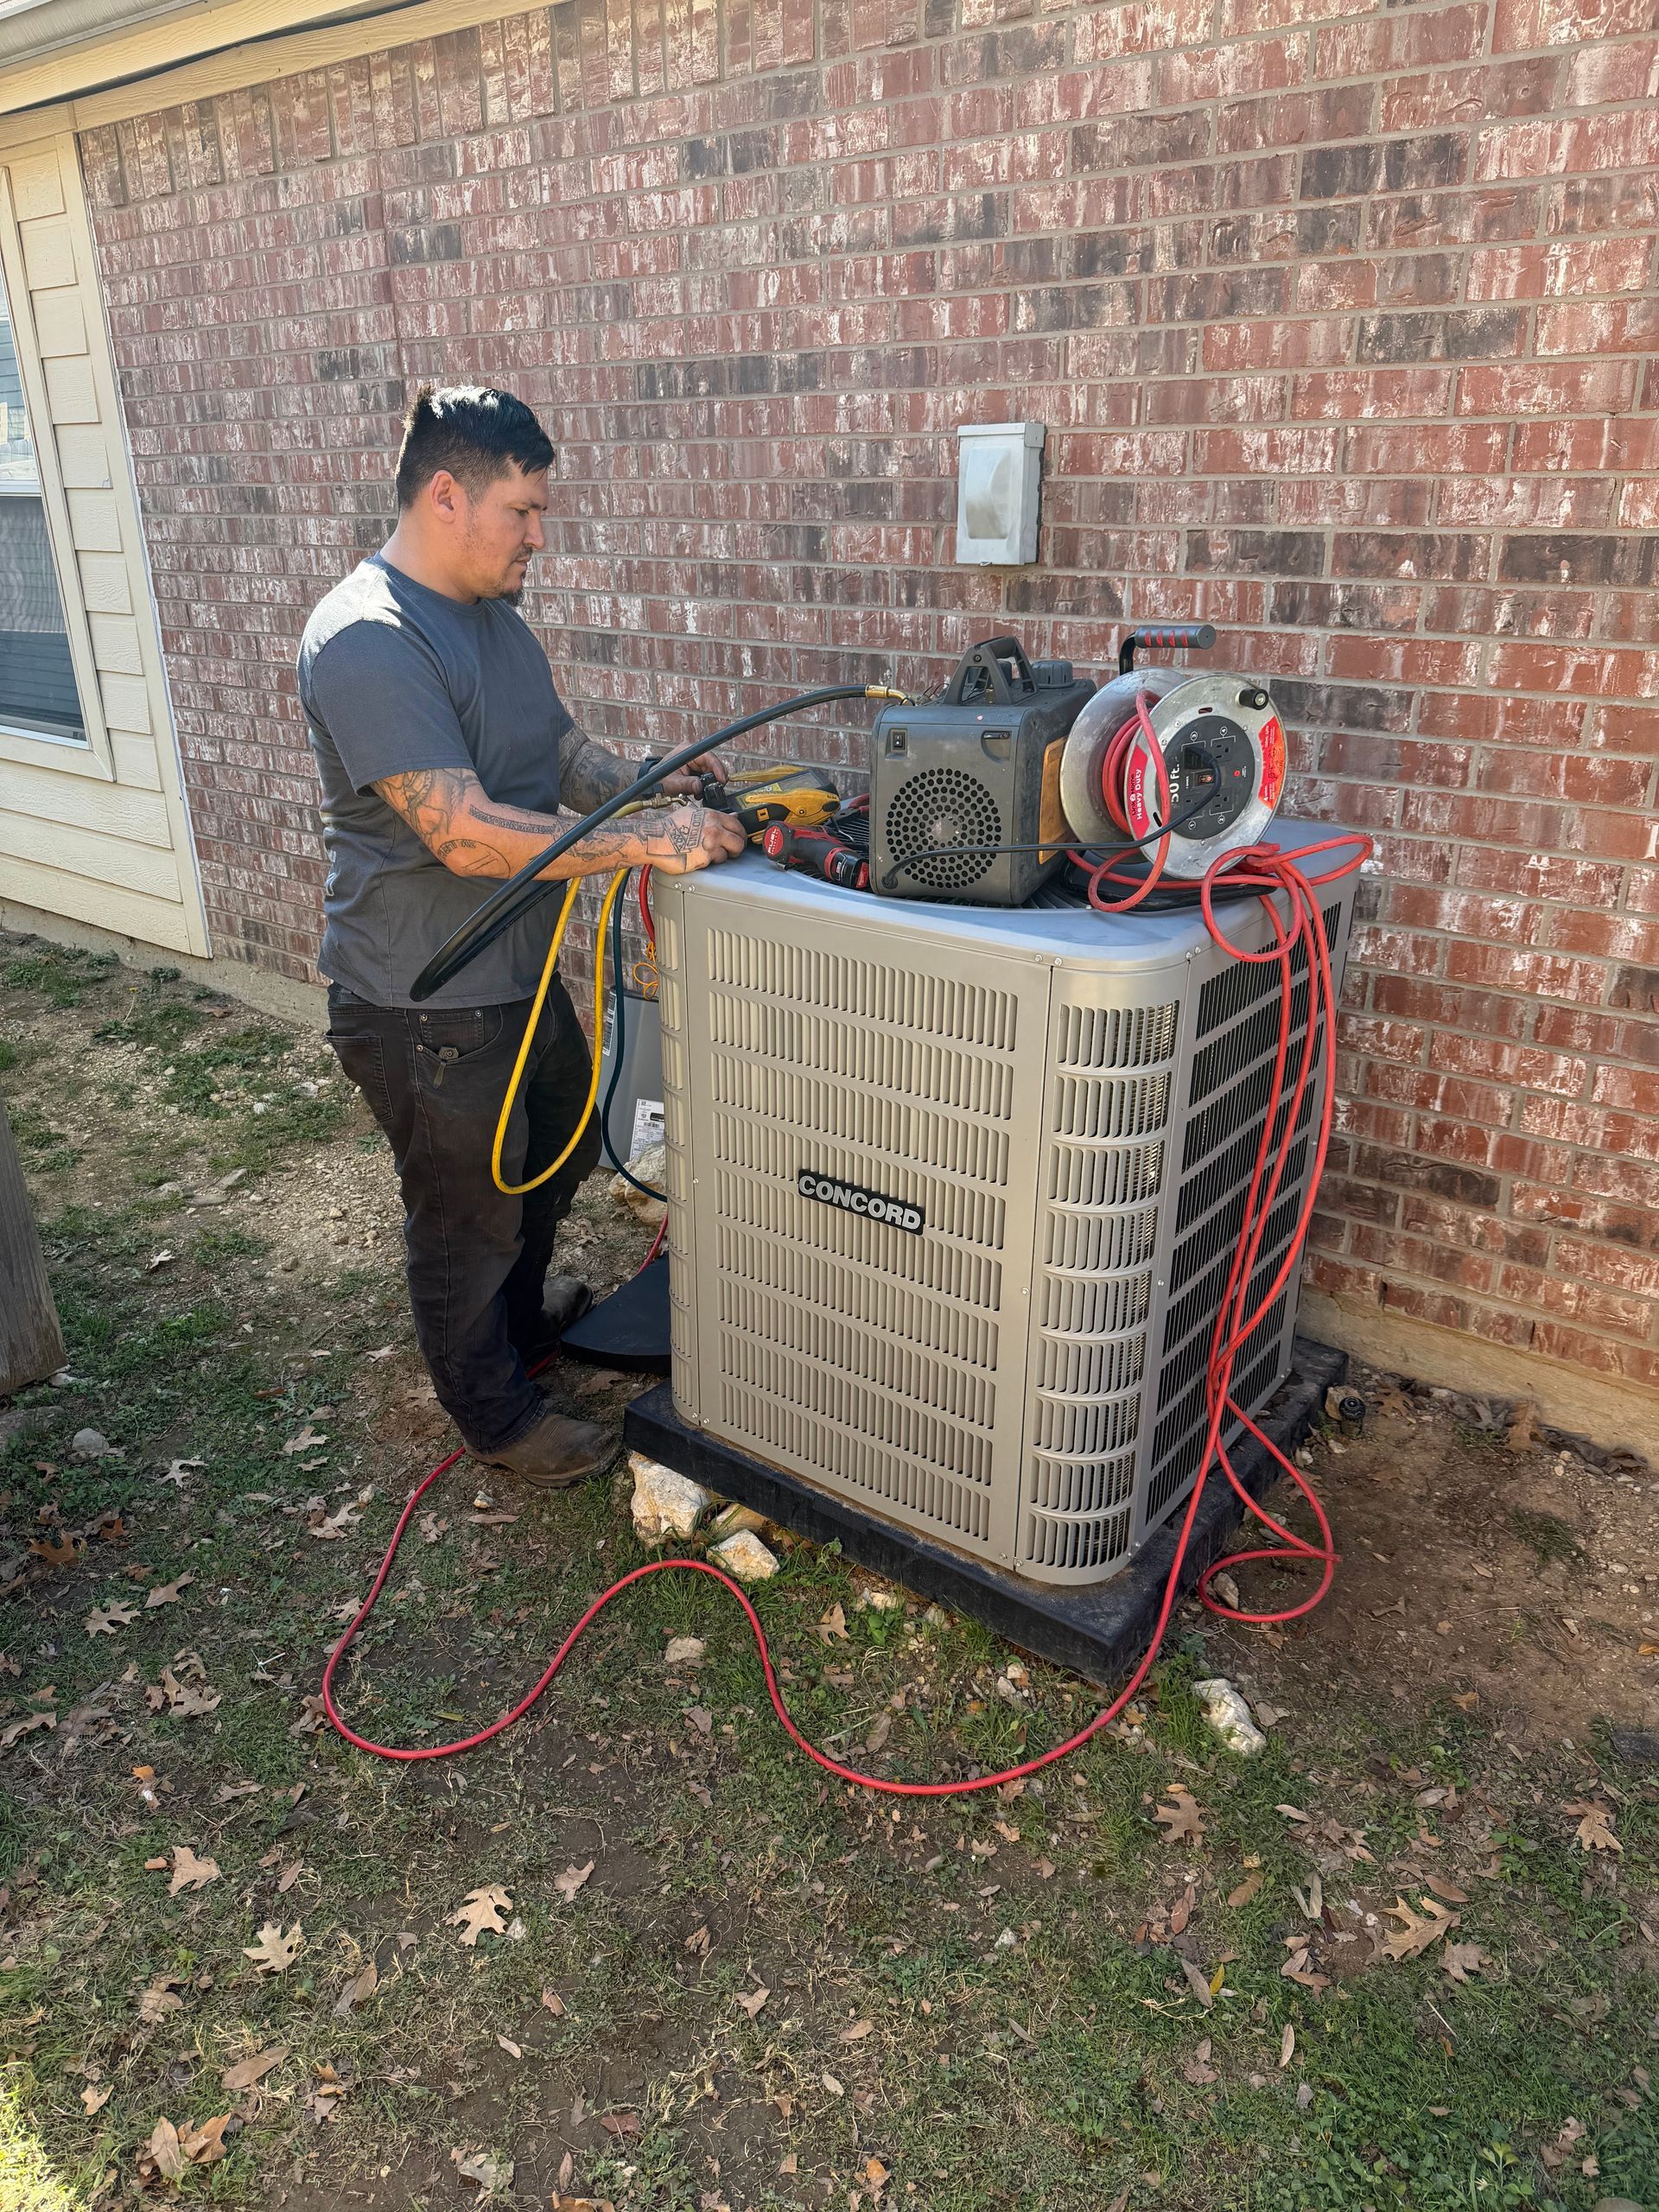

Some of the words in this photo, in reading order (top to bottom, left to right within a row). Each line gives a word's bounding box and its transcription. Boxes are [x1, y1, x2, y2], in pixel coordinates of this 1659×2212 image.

[1170, 764, 1180, 780] ft.
[767, 828, 777, 854] FUEL
[798, 1175, 921, 1230] CONCORD
